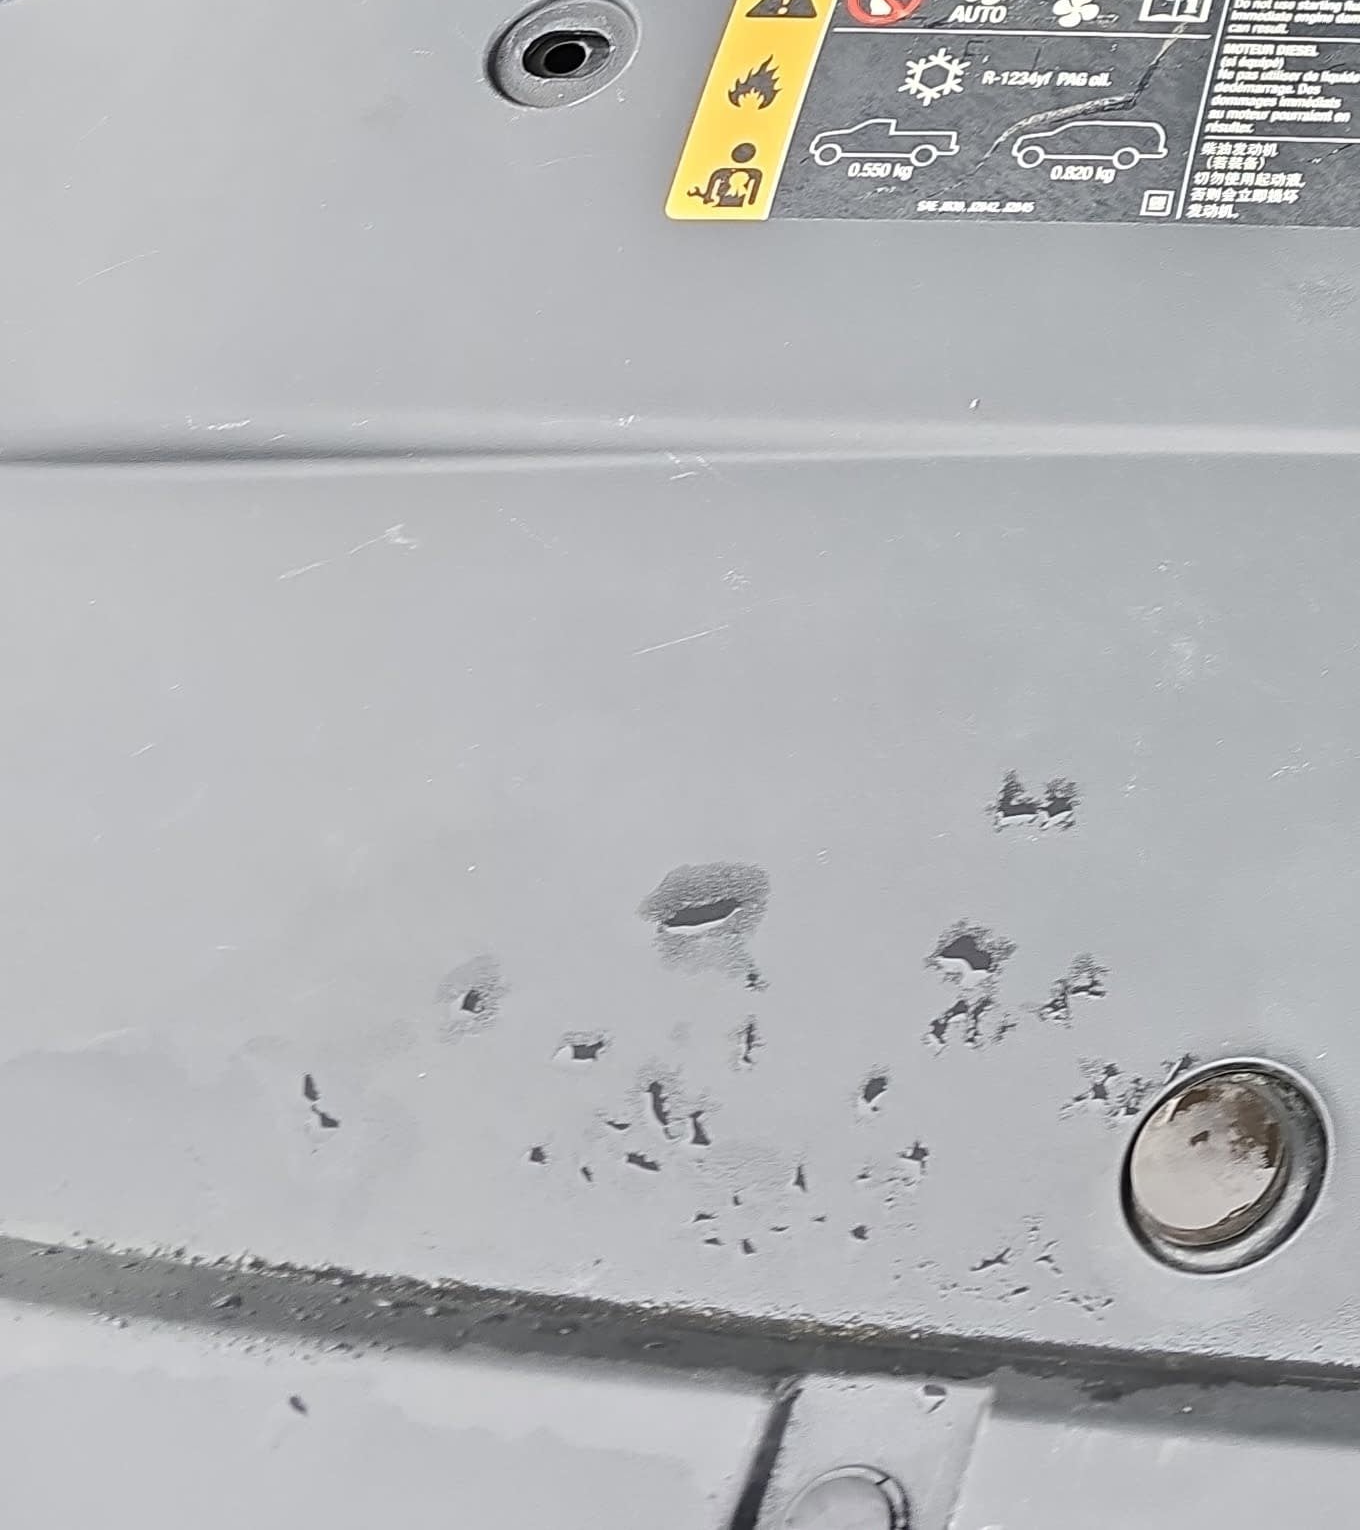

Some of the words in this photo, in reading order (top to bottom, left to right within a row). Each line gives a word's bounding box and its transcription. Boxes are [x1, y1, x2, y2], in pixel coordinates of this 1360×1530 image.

[949, 5, 1008, 24] AUTO
[1252, 0, 1273, 9] not
[1274, 1, 1296, 10] use
[1297, 0, 1342, 13] starting
[1228, 24, 1251, 33] can
[1200, 142, 1279, 157] 柴油发动机
[848, 162, 894, 178] 0.550
[894, 164, 913, 181] kg
[1094, 166, 1116, 183] kg
